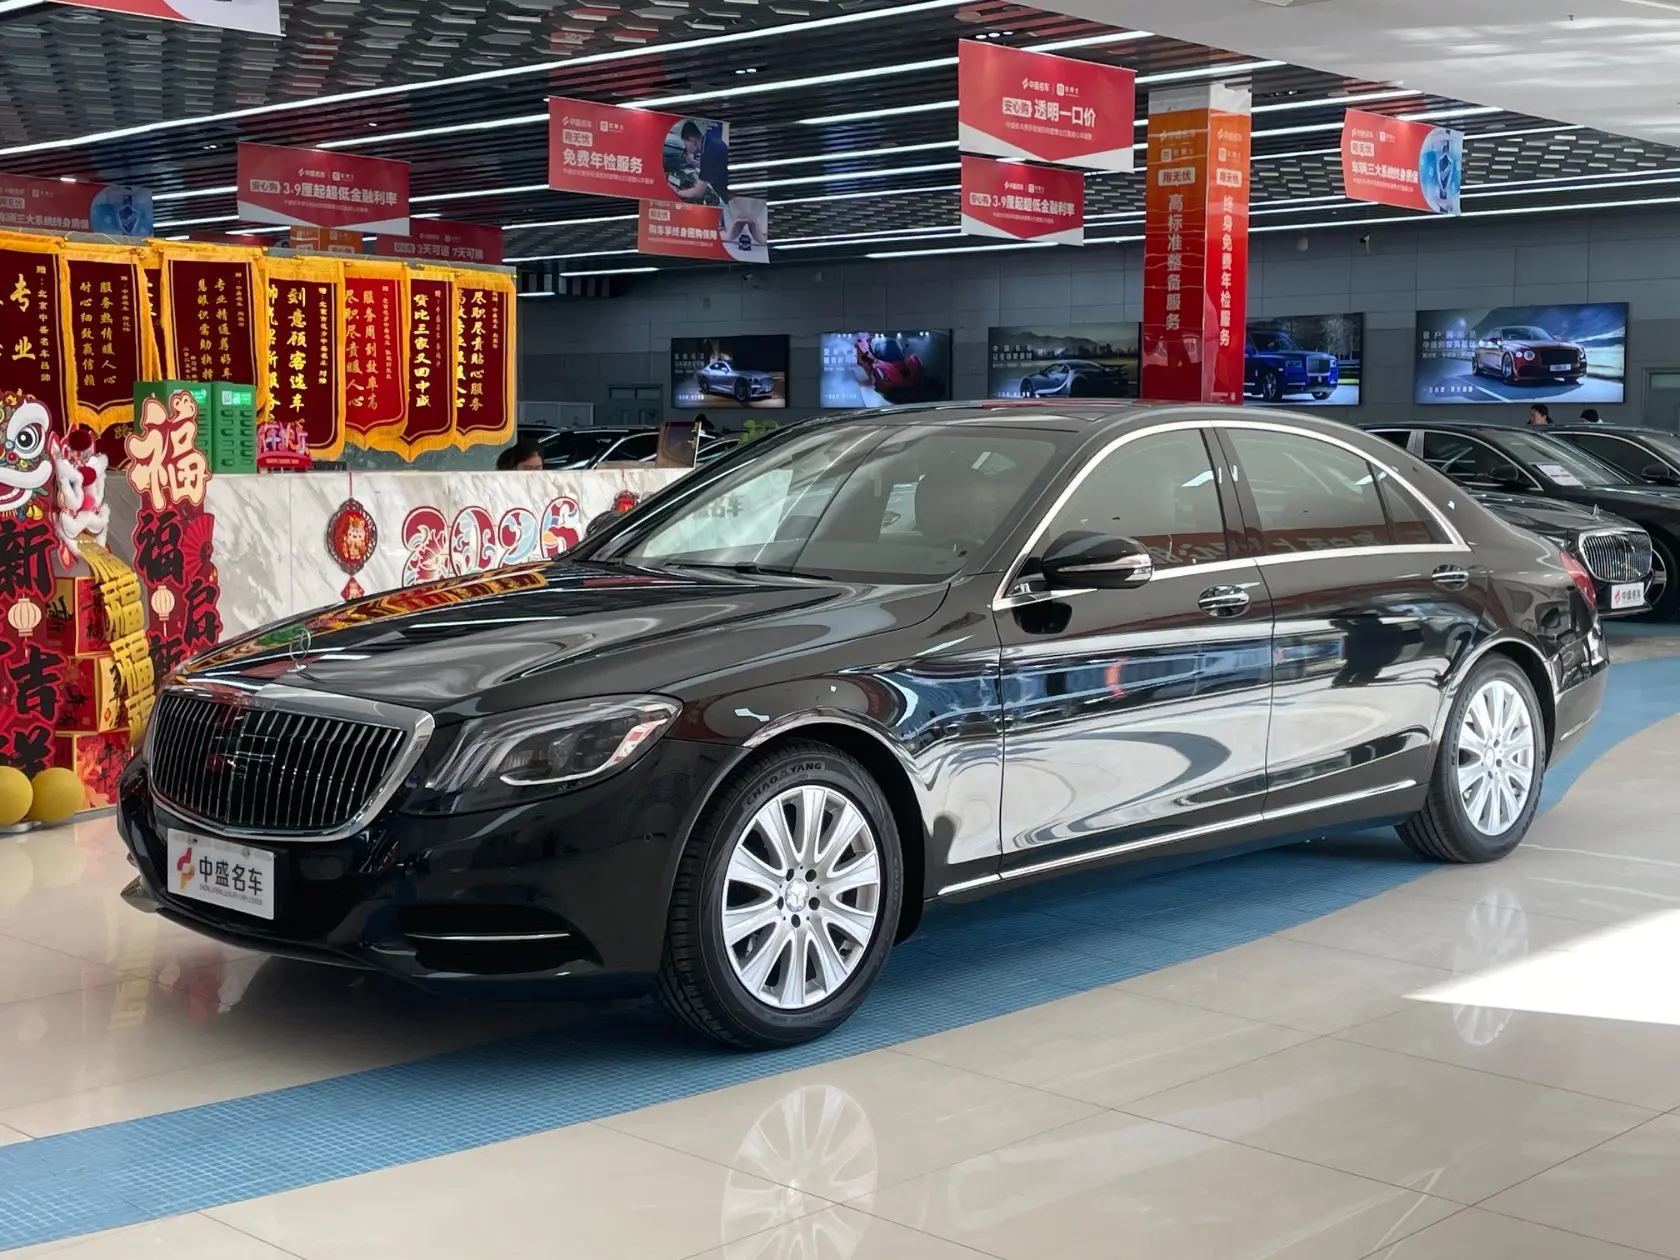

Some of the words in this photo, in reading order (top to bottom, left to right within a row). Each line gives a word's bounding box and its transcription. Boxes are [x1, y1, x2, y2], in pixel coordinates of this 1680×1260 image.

[1034, 98, 1096, 128] 透明一口价
[563, 147, 643, 174] 免费年检服务
[1163, 170, 1192, 182] 用无忧
[283, 182, 398, 206] 3.9厘起超低金融利率
[993, 195, 1075, 216] 3.9厘起超低金融利率
[1165, 193, 1184, 331] 高标准整备服务
[1219, 195, 1234, 346] 终身免费年检服务
[10, 273, 36, 361] 专业
[100, 281, 117, 385] 服务热情暖人心
[401, 496, 580, 586] 2026
[747, 775, 778, 805] CHAO
[790, 763, 822, 773] YANG
[199, 855, 263, 896] 中盛名车
